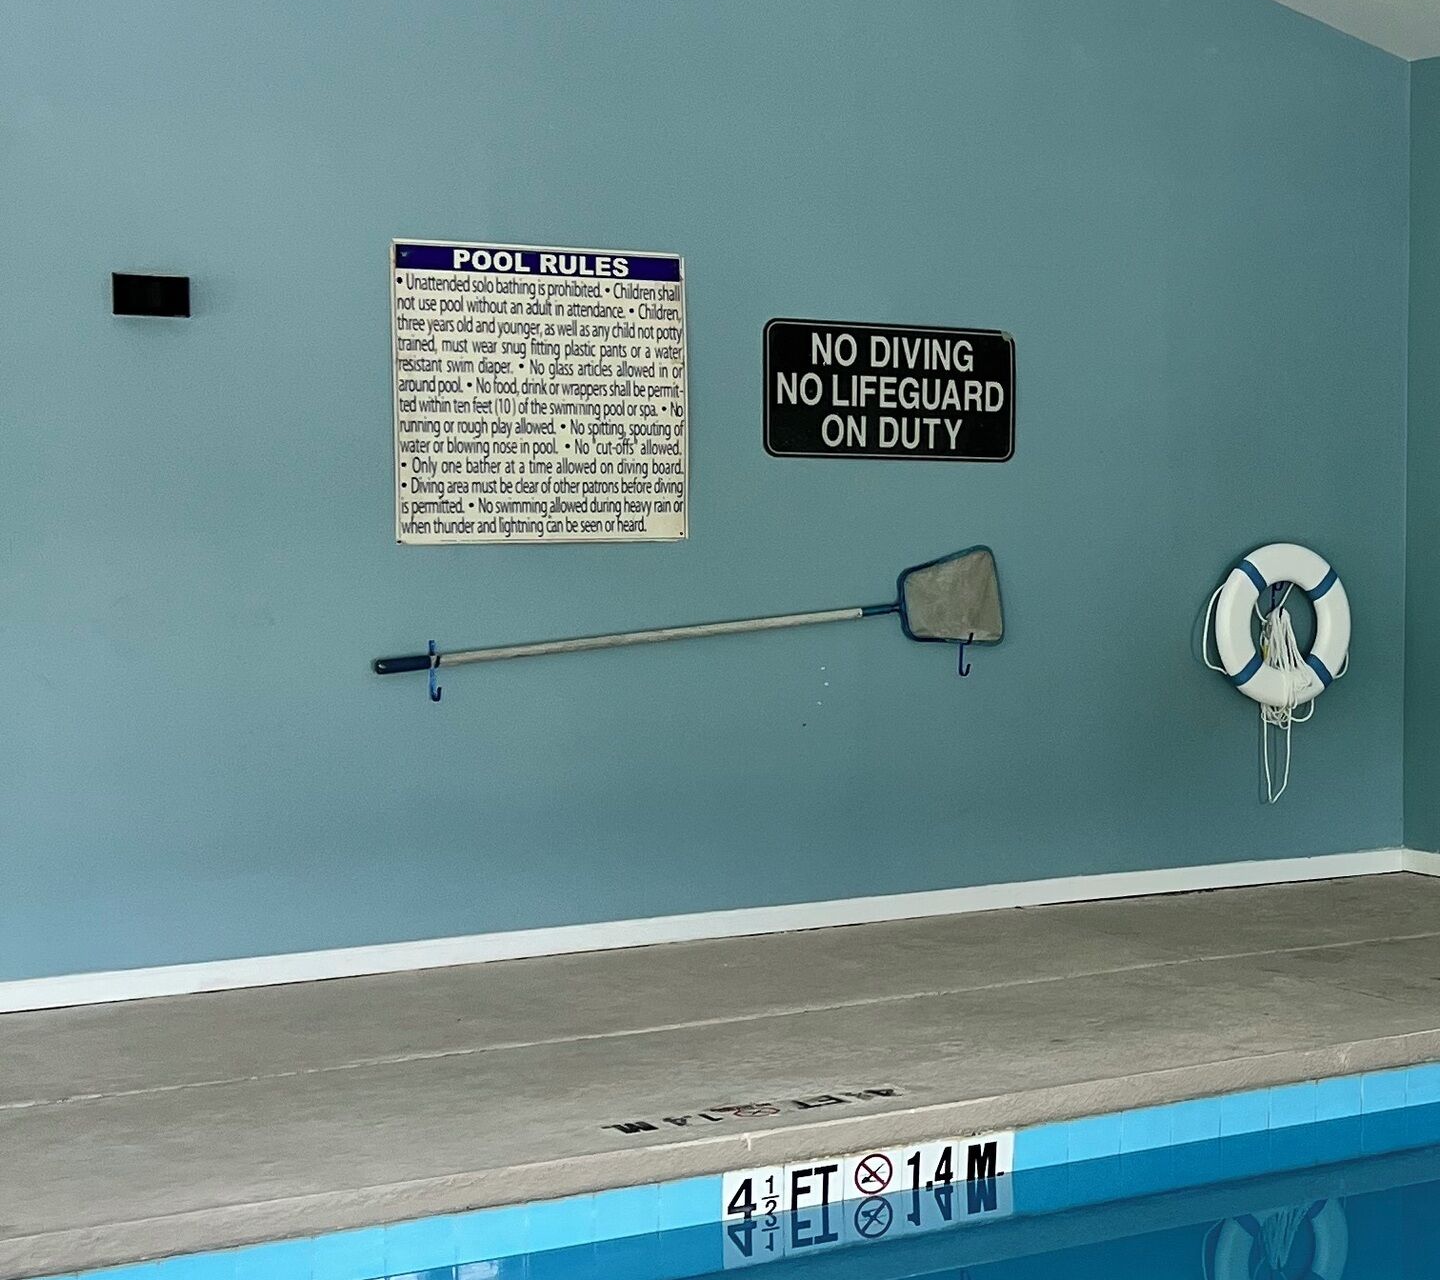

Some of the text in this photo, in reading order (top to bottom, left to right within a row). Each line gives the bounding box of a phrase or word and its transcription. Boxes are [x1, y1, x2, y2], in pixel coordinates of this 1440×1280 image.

[453, 249, 629, 277] POOL RULES
[406, 273, 680, 301] Unattended solo bathing is prohibited. Children shall
[397, 297, 415, 310] not
[418, 299, 436, 311] use
[440, 295, 463, 315] pool
[466, 296, 507, 314] without
[510, 302, 523, 314] an
[526, 298, 552, 316] adult
[555, 300, 564, 316] in
[567, 301, 625, 318] attendance.
[397, 313, 682, 344] three years old and younger, as well as any child not potty
[398, 335, 682, 362] trained, must wear snug fitting plastic pants or a water
[811, 332, 974, 372] NO DIVING
[399, 356, 682, 379] resistant swim diaper. No glass articles allowed in or
[398, 375, 684, 401] around pool. No food, drink or wrappers shall be permit-
[777, 372, 1004, 412] NO LIFEGUARD
[400, 396, 416, 412] ted
[419, 396, 451, 413] within
[454, 399, 470, 413] ten
[473, 396, 492, 414] feet
[519, 397, 529, 414] of
[531, 398, 547, 414] the
[550, 399, 600, 420] swimming
[604, 400, 625, 419] pool
[627, 404, 637, 416] or
[640, 405, 658, 420] spa.
[671, 402, 684, 417] No
[400, 416, 684, 441] running or rough play allowed. No spitting, spouting of
[822, 414, 962, 449] ON DUTY
[400, 439, 430, 453] water
[433, 441, 444, 453] or
[447, 436, 489, 459] blowing
[493, 441, 517, 454] nose
[520, 438, 529, 453] in
[533, 437, 558, 460] pool.
[575, 439, 589, 454] No
[641, 440, 682, 455] allowed.
[412, 456, 684, 478] Only one bather at a time allowed on diving board.
[411, 476, 683, 499] Diving area must be clear of other patrons before diving
[401, 497, 683, 521] is permitted. No swimming allowed during heavy rain or
[401, 516, 646, 537] when thunder and lightning can be seen or heard.
[791, 1164, 838, 1210] FT
